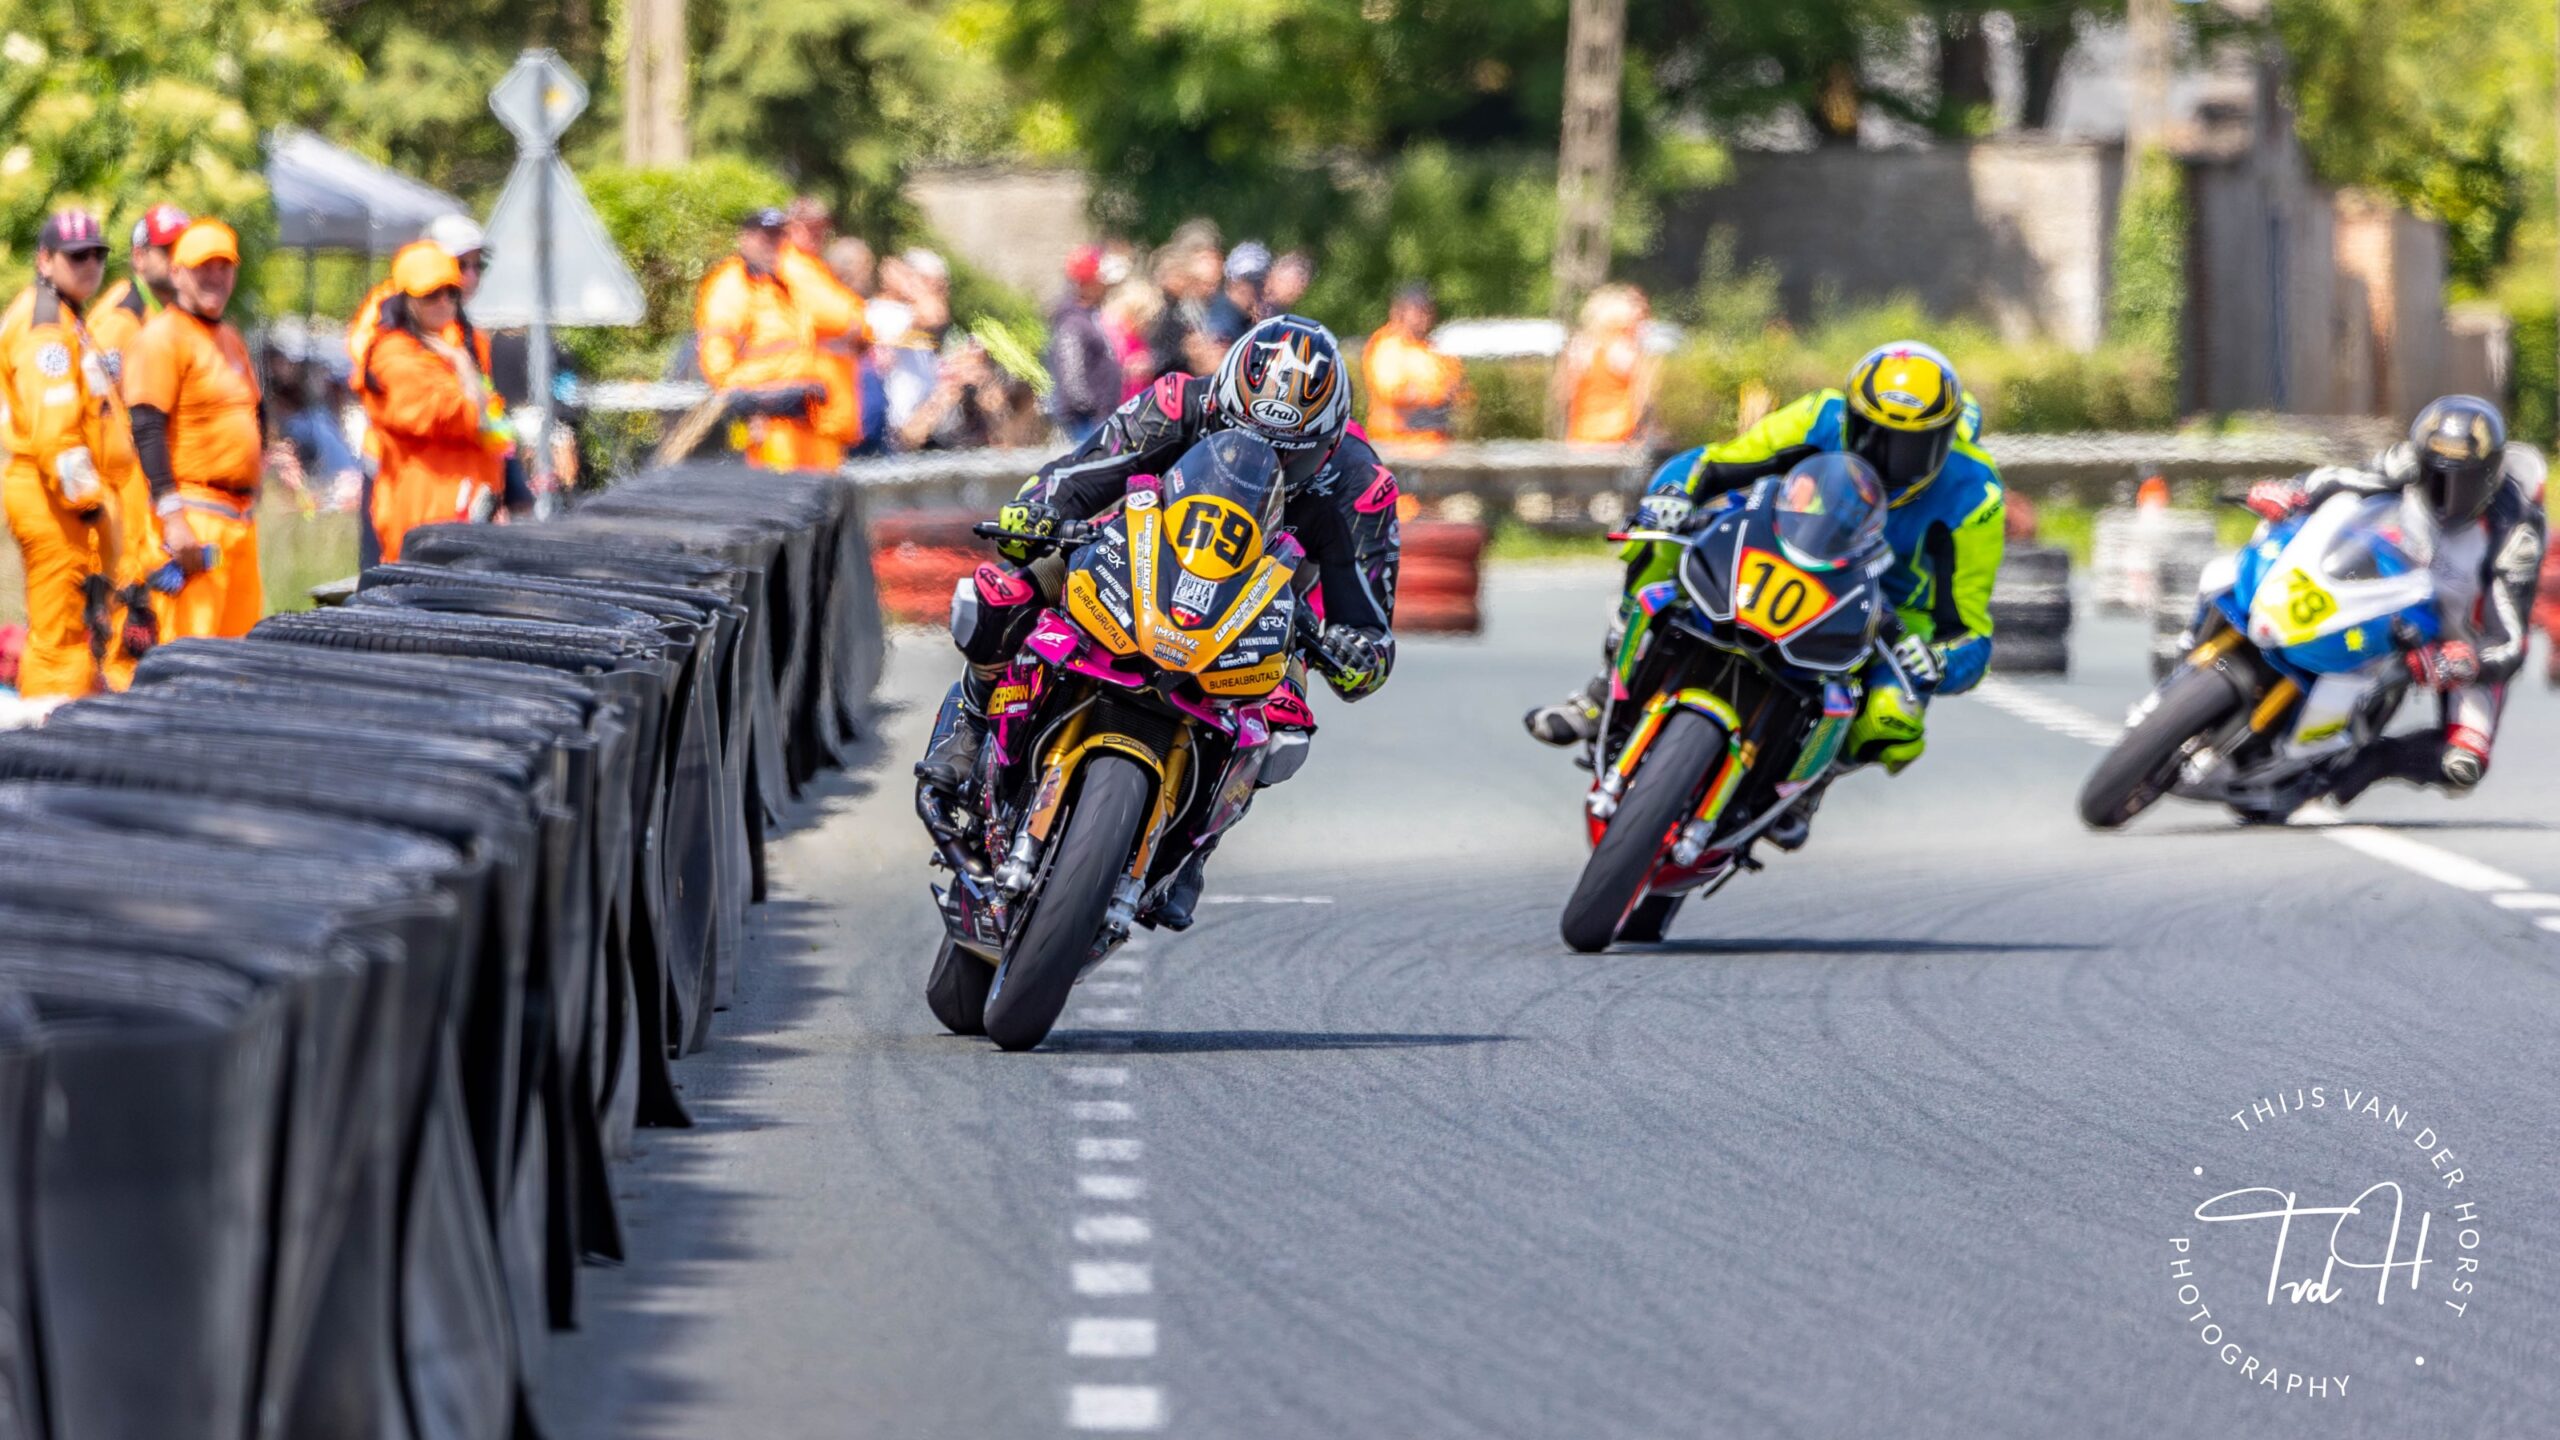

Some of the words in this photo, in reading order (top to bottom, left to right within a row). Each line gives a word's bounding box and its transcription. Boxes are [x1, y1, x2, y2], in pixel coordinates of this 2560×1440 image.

[1256, 403, 1295, 421] Arai
[1177, 501, 1253, 569] 69
[1181, 578, 1210, 597] OUTTA
[1744, 561, 1807, 626] 10
